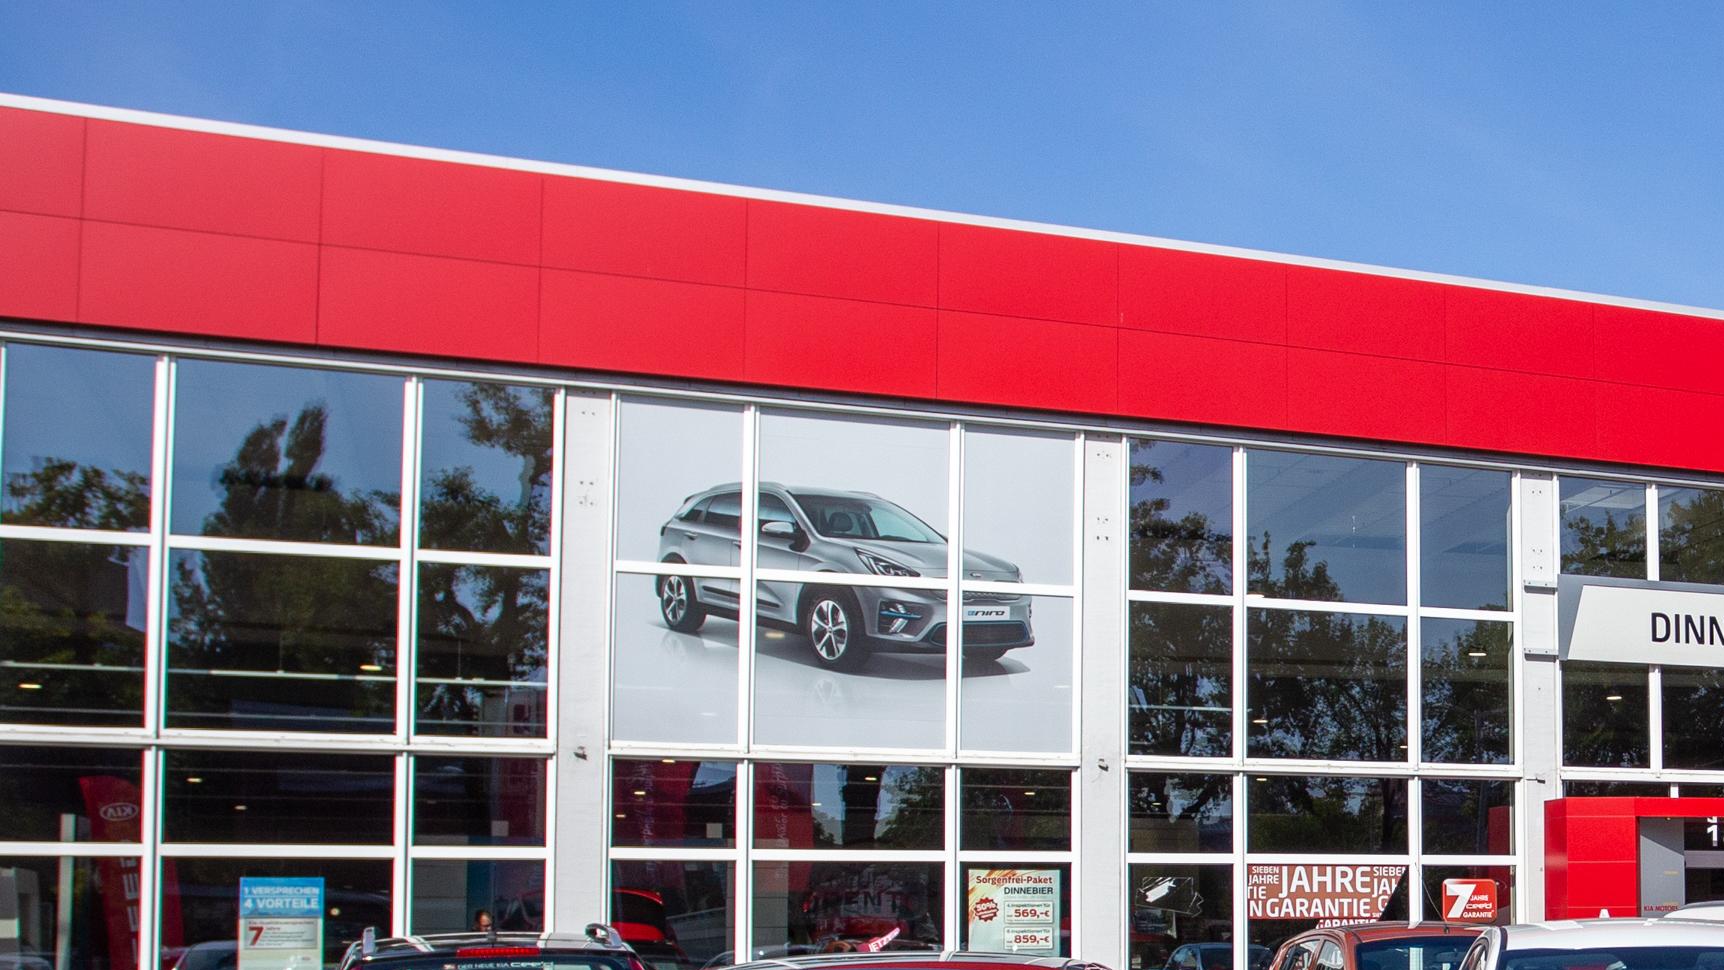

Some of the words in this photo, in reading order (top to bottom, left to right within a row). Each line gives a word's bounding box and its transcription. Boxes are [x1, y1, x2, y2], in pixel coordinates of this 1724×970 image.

[1252, 866, 1279, 874] SIEBEN
[976, 876, 1052, 885] Sorgenfrei-Paket
[1249, 875, 1279, 885] JAHRE
[1279, 866, 1371, 898] JAHRE
[256, 898, 318, 909] VORTEILE
[1266, 898, 1370, 918] GARANTIE
[248, 926, 264, 946] 7
